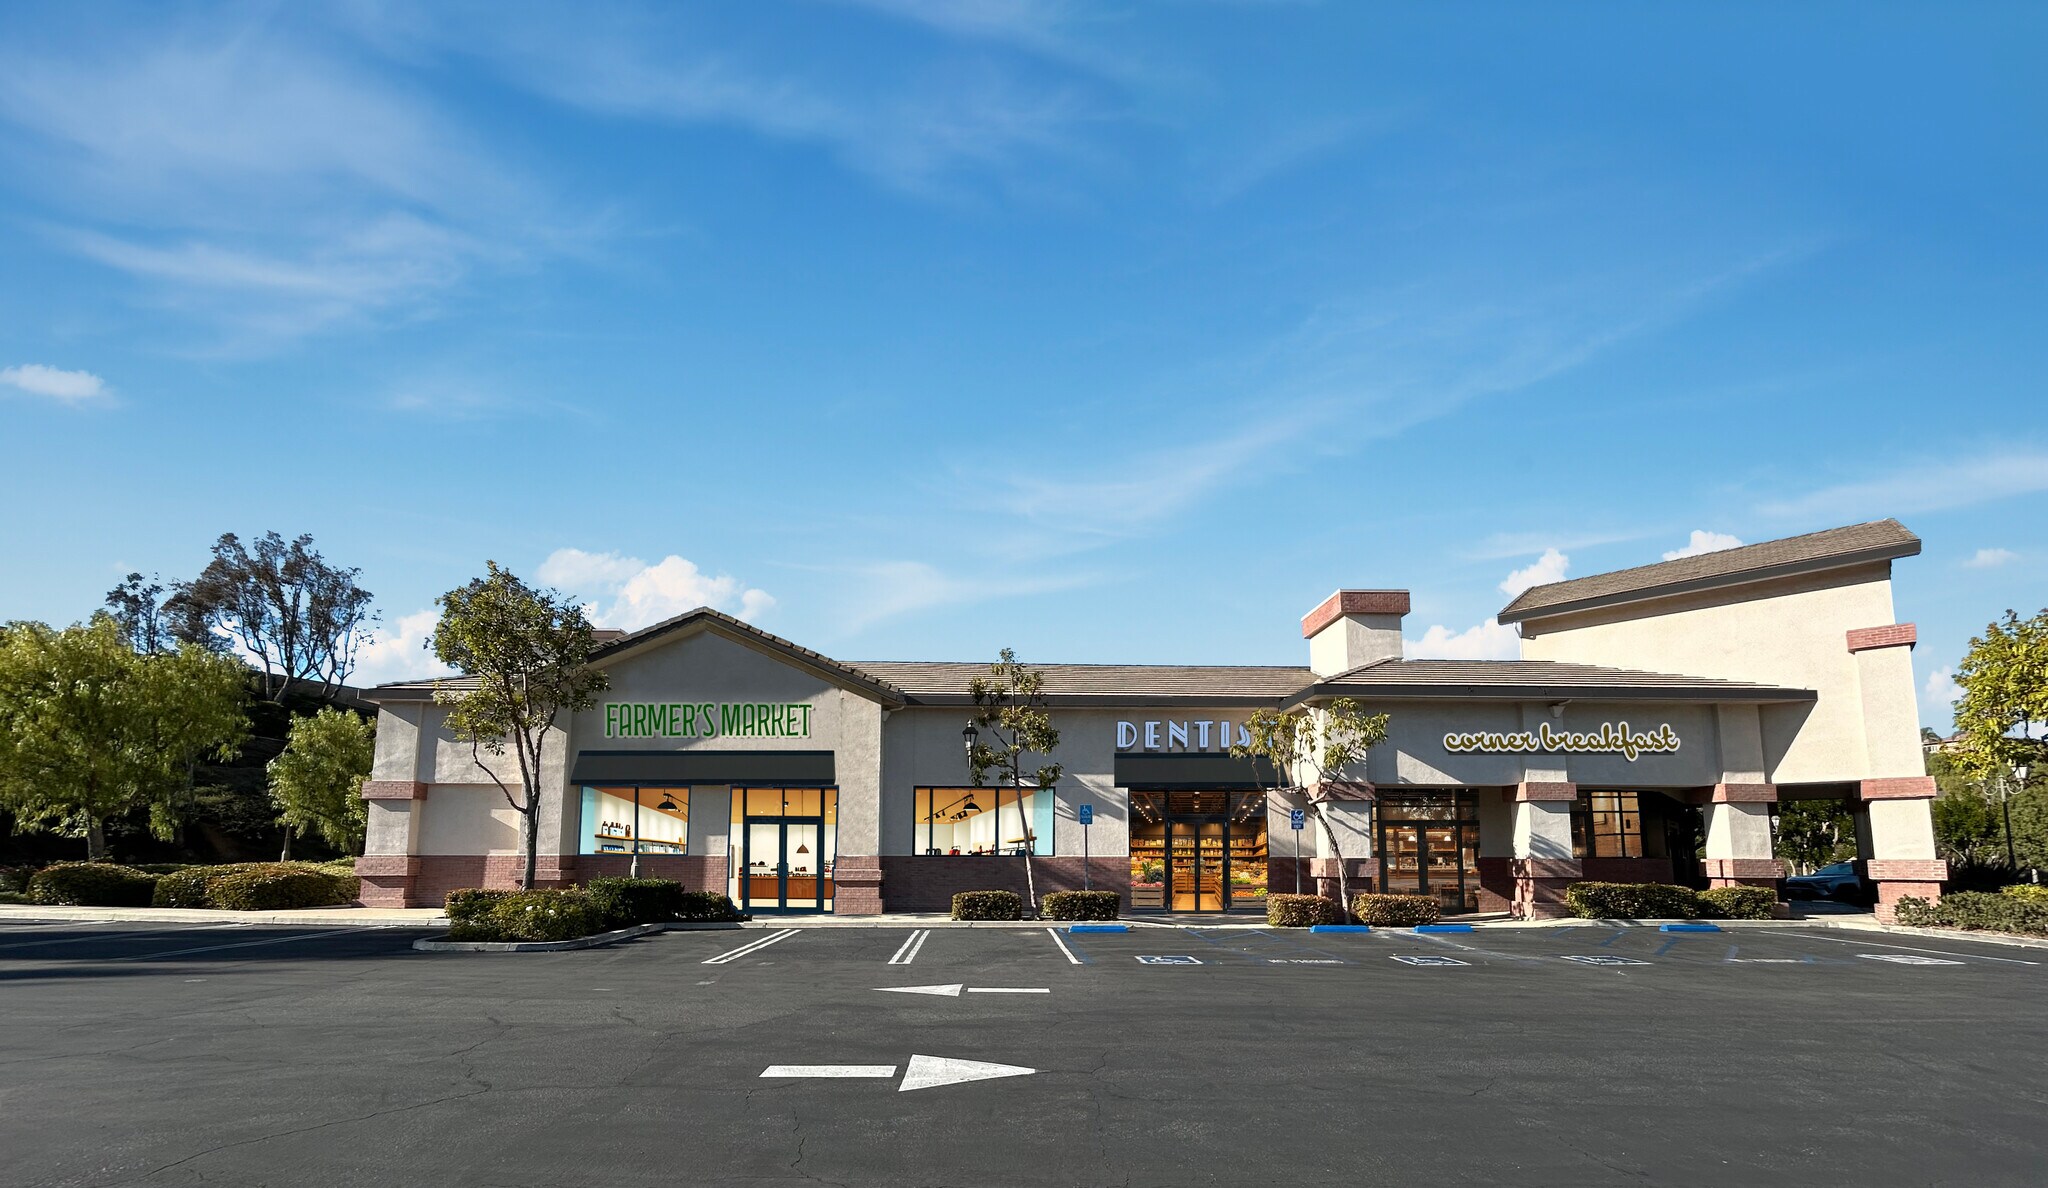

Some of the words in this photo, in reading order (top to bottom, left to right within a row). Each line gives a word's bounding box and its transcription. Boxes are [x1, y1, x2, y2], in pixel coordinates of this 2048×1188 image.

[605, 703, 716, 737] FARMER'S
[720, 703, 814, 737] MARKET
[1443, 731, 1539, 752] corner
[1540, 721, 1680, 762] breakfast
